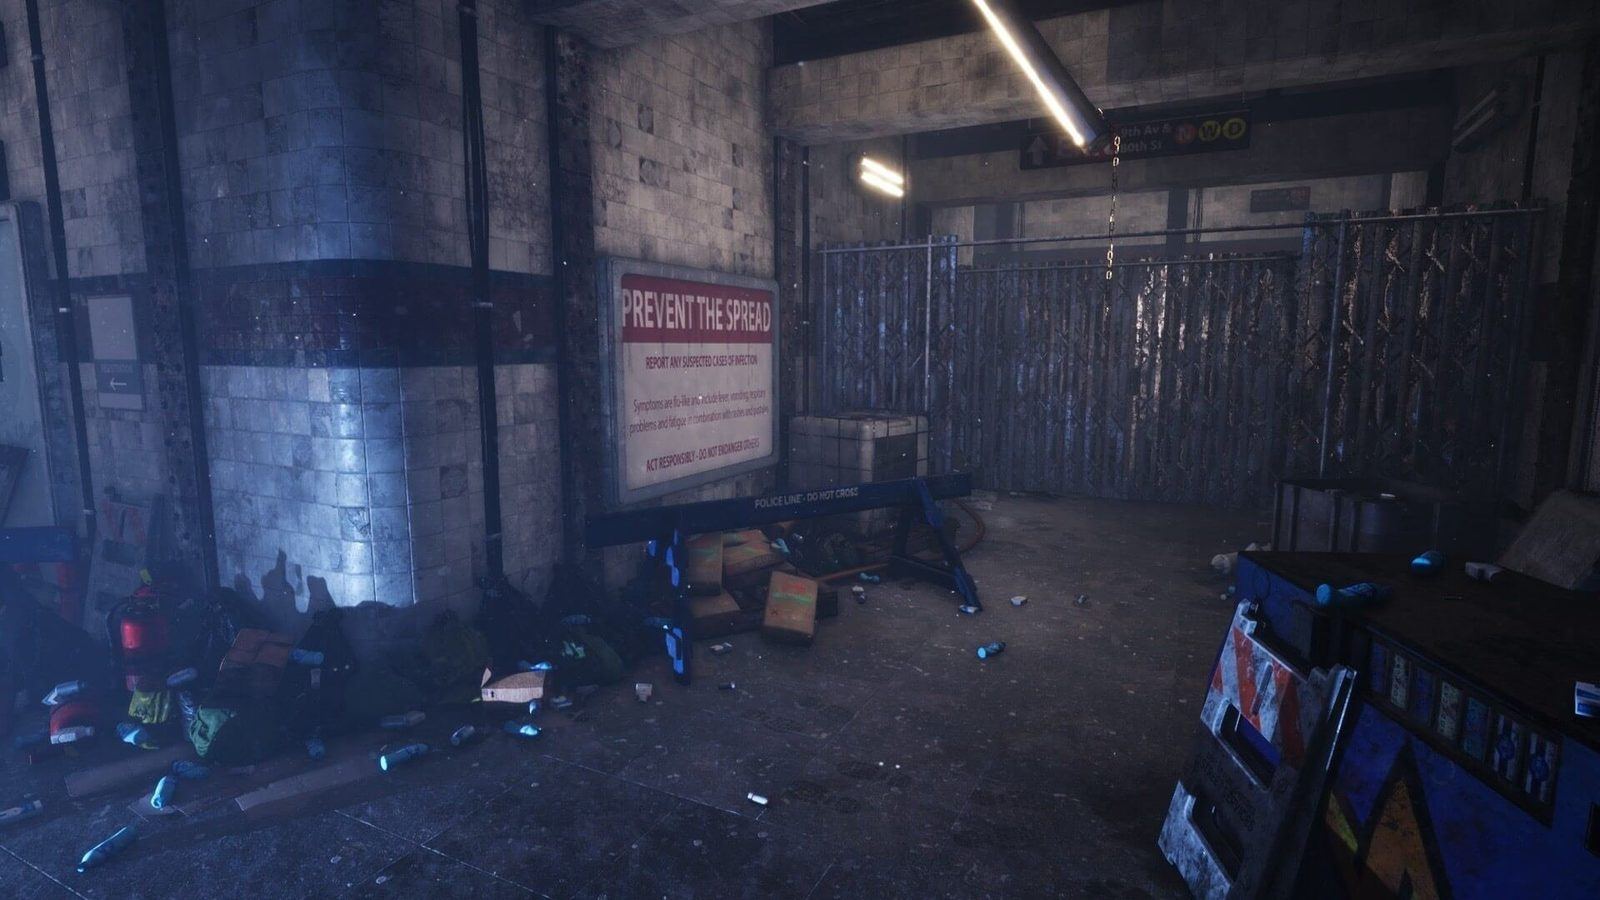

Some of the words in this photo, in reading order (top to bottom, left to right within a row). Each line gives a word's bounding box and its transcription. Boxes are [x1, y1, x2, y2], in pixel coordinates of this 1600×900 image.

[622, 288, 695, 330] PREVENT
[697, 296, 723, 330] THE
[726, 299, 771, 332] SPREAD
[645, 356, 669, 369] REPORT
[669, 355, 682, 369] ANY
[682, 355, 712, 368] SUSPECTED
[713, 354, 727, 367] CASES
[728, 354, 735, 366] OF
[735, 354, 758, 366] INFECTION
[633, 399, 663, 415] Symptoms
[664, 399, 672, 409] are
[629, 420, 657, 437] problems
[657, 418, 669, 431] and
[669, 415, 686, 431] fatigue
[646, 458, 658, 472] ACT
[659, 450, 696, 469] RESPONSIBLY
[699, 449, 707, 461] DO
[708, 446, 718, 458] NOT
[718, 441, 743, 456] ENDANGER
[755, 495, 783, 508] POLICE
[784, 494, 803, 506] LINE
[807, 492, 818, 502] DO
[819, 490, 835, 500] NOT
[835, 487, 859, 498] CROSS
